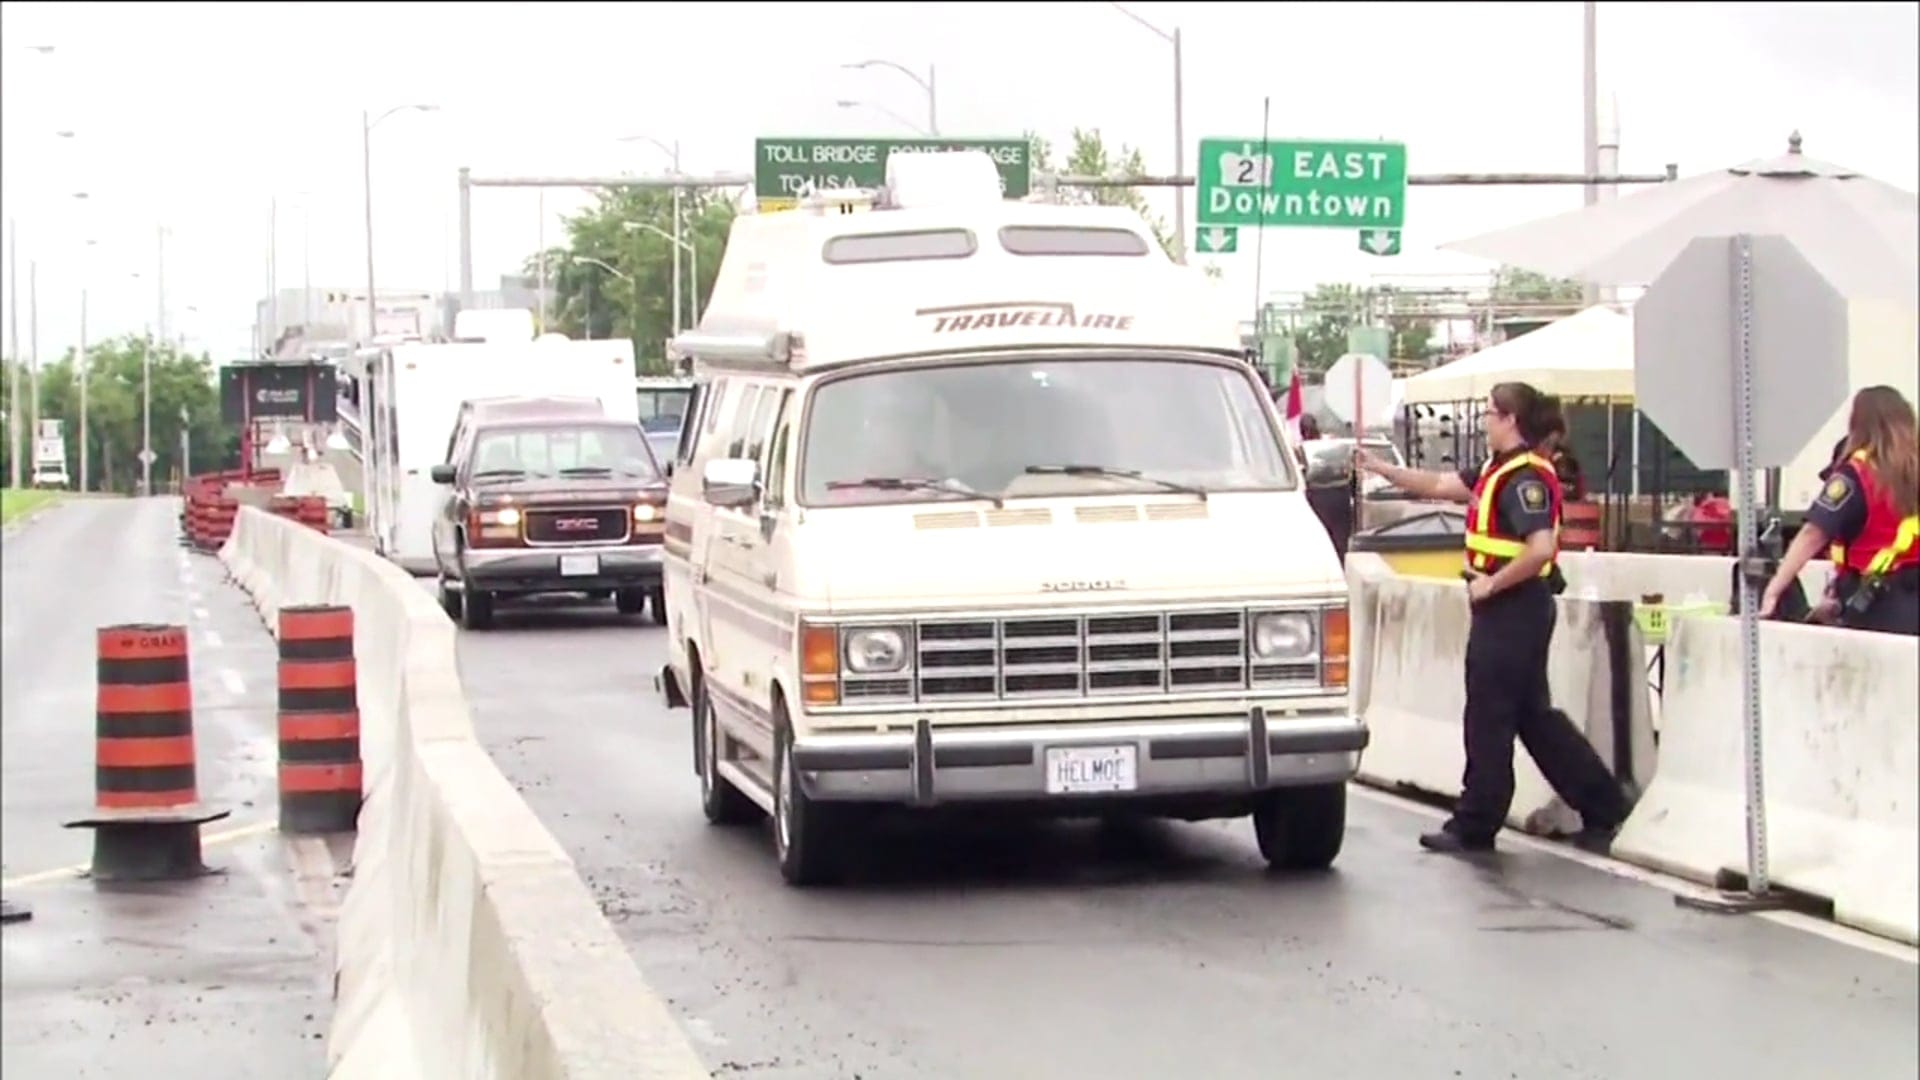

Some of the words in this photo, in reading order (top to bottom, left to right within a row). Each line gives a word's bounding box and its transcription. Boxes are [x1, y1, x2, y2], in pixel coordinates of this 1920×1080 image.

[764, 145, 808, 163] TOLL
[812, 145, 877, 163] BRIDGE
[1237, 160, 1254, 182] 2
[1294, 151, 1387, 180] EAST
[1209, 186, 1391, 218] Downtown
[915, 300, 1135, 333] TRAVELAIRE
[556, 518, 599, 531] GMC
